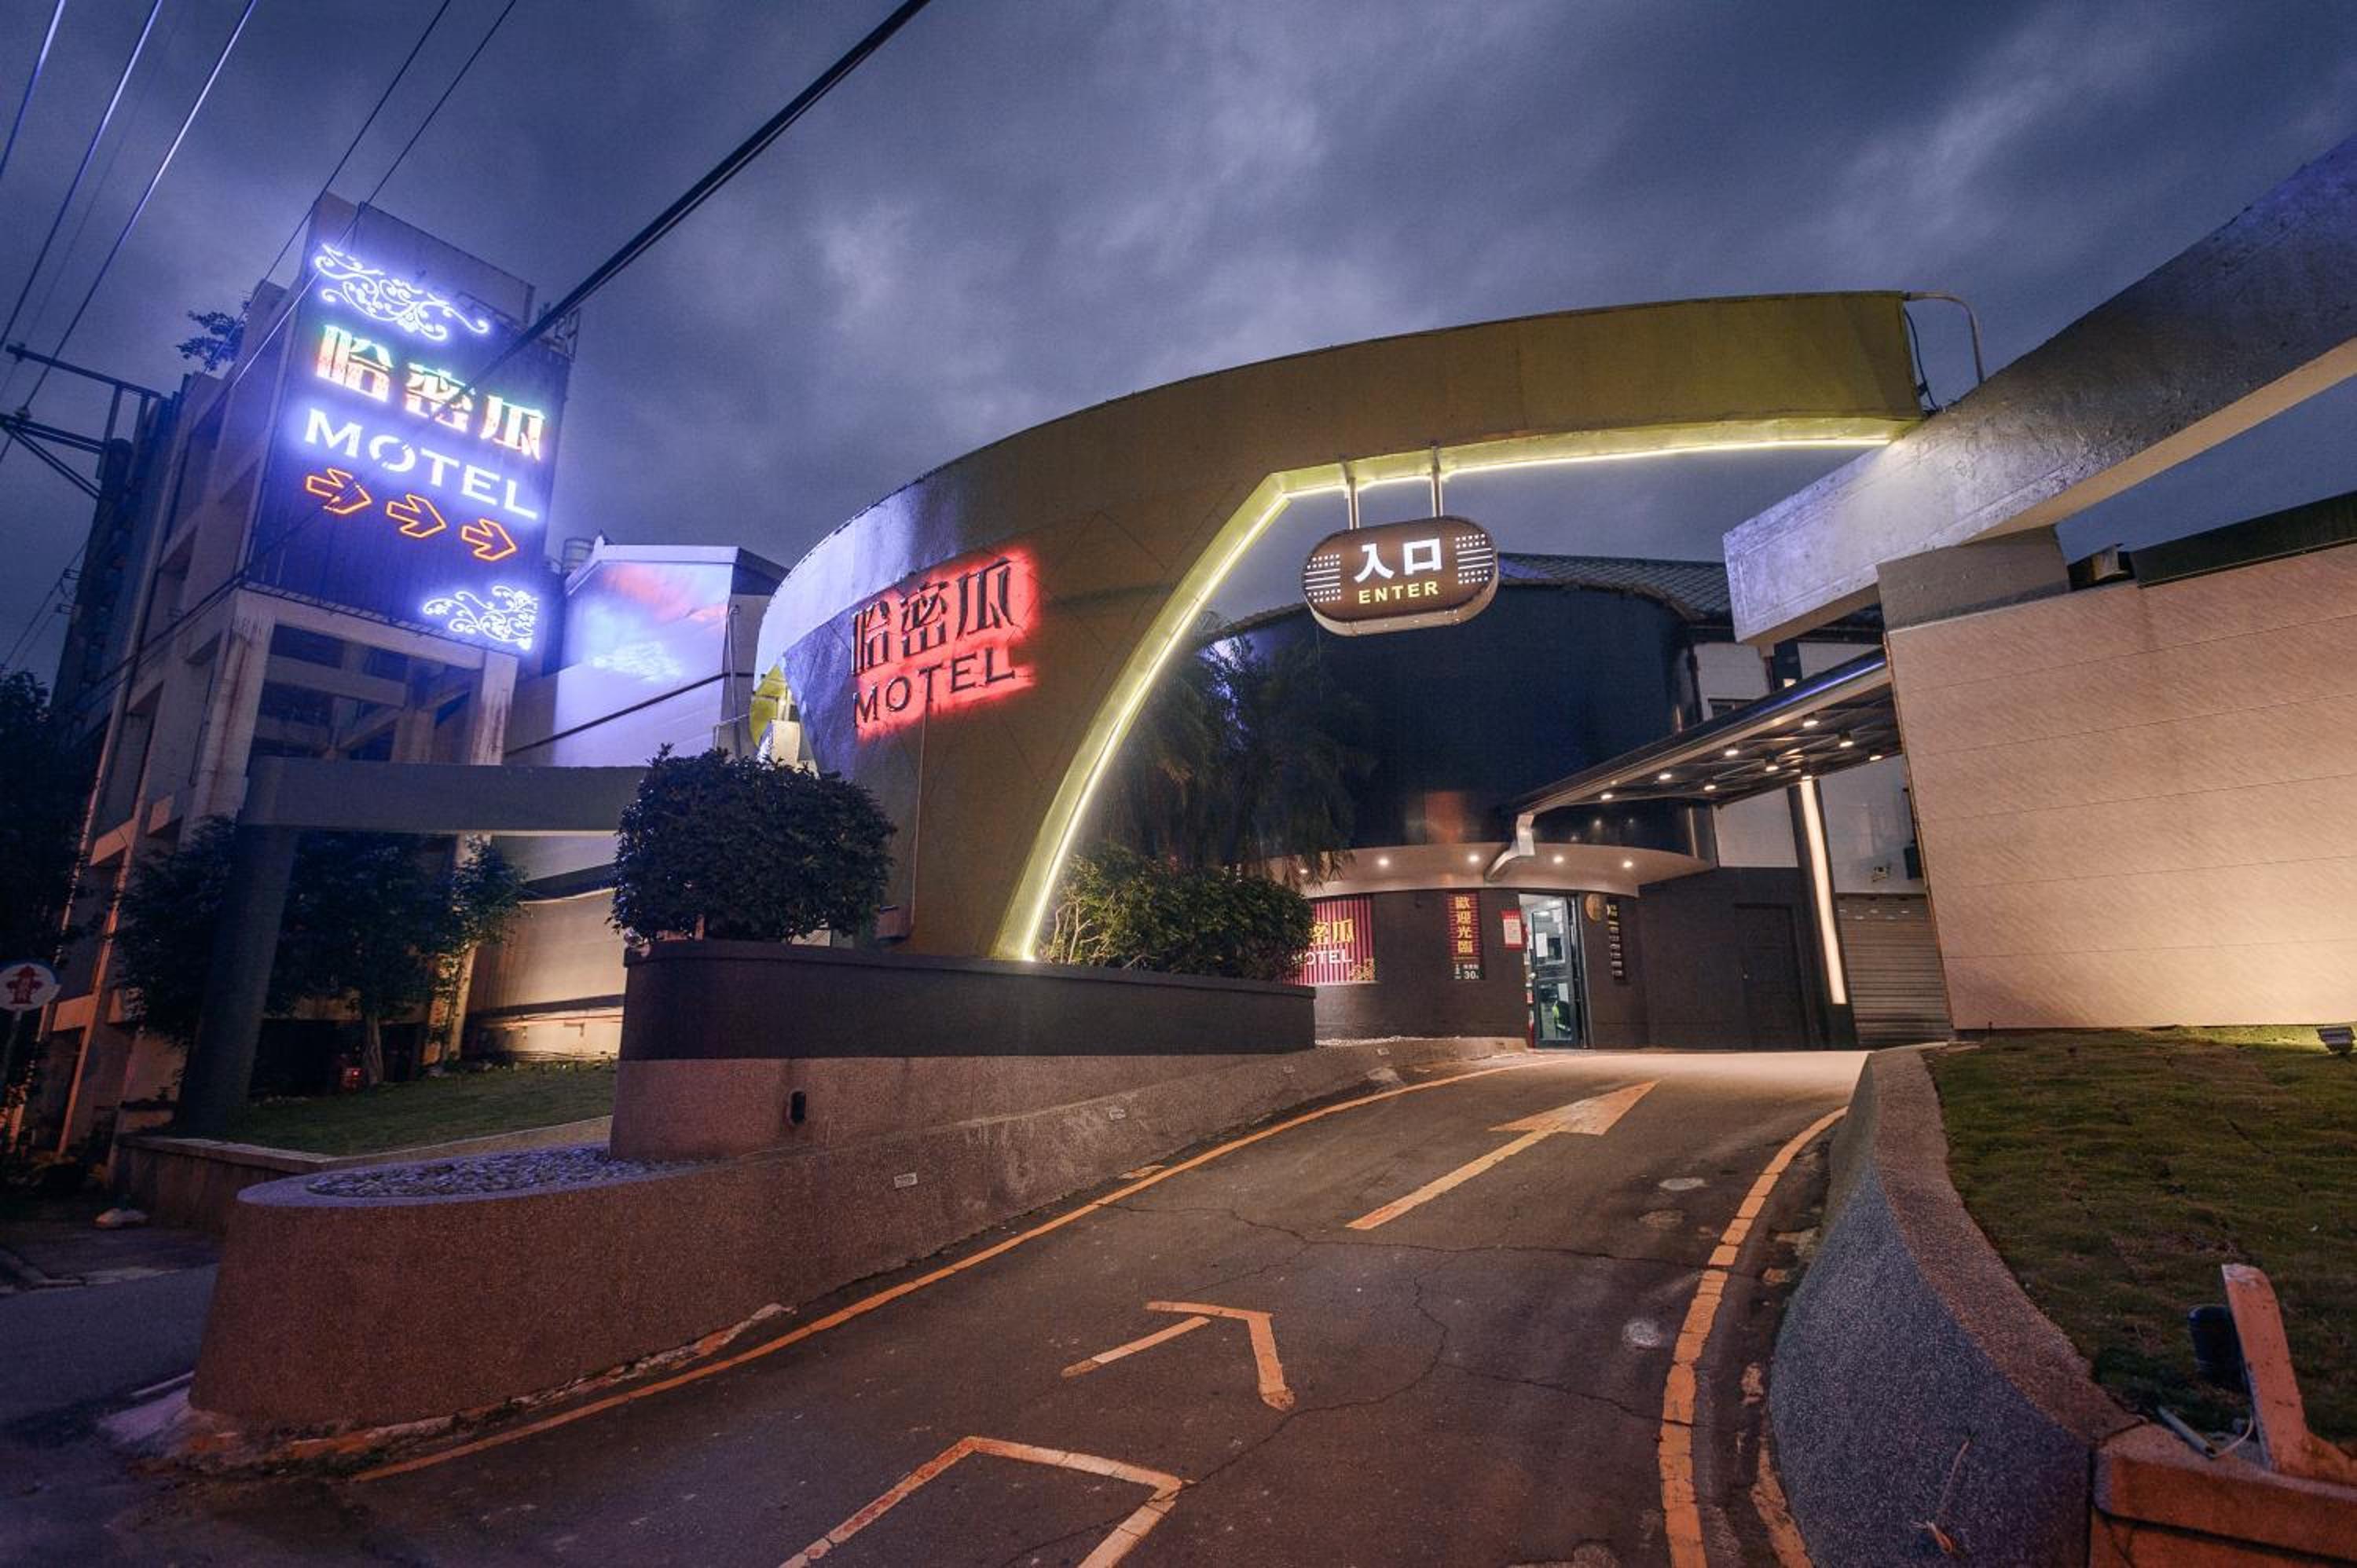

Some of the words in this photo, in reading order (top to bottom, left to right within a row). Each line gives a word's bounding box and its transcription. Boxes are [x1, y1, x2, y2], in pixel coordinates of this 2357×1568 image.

[314, 324, 546, 461] 哈密瓜
[304, 408, 538, 520] MOTEL
[1354, 538, 1442, 583] 入口
[1358, 581, 1439, 604] ENTER
[852, 556, 1014, 675] 哈密瓜
[853, 647, 1014, 728] MOTEL
[1310, 918, 1354, 947] 密瓜
[1454, 896, 1473, 953] 歡迎光臨
